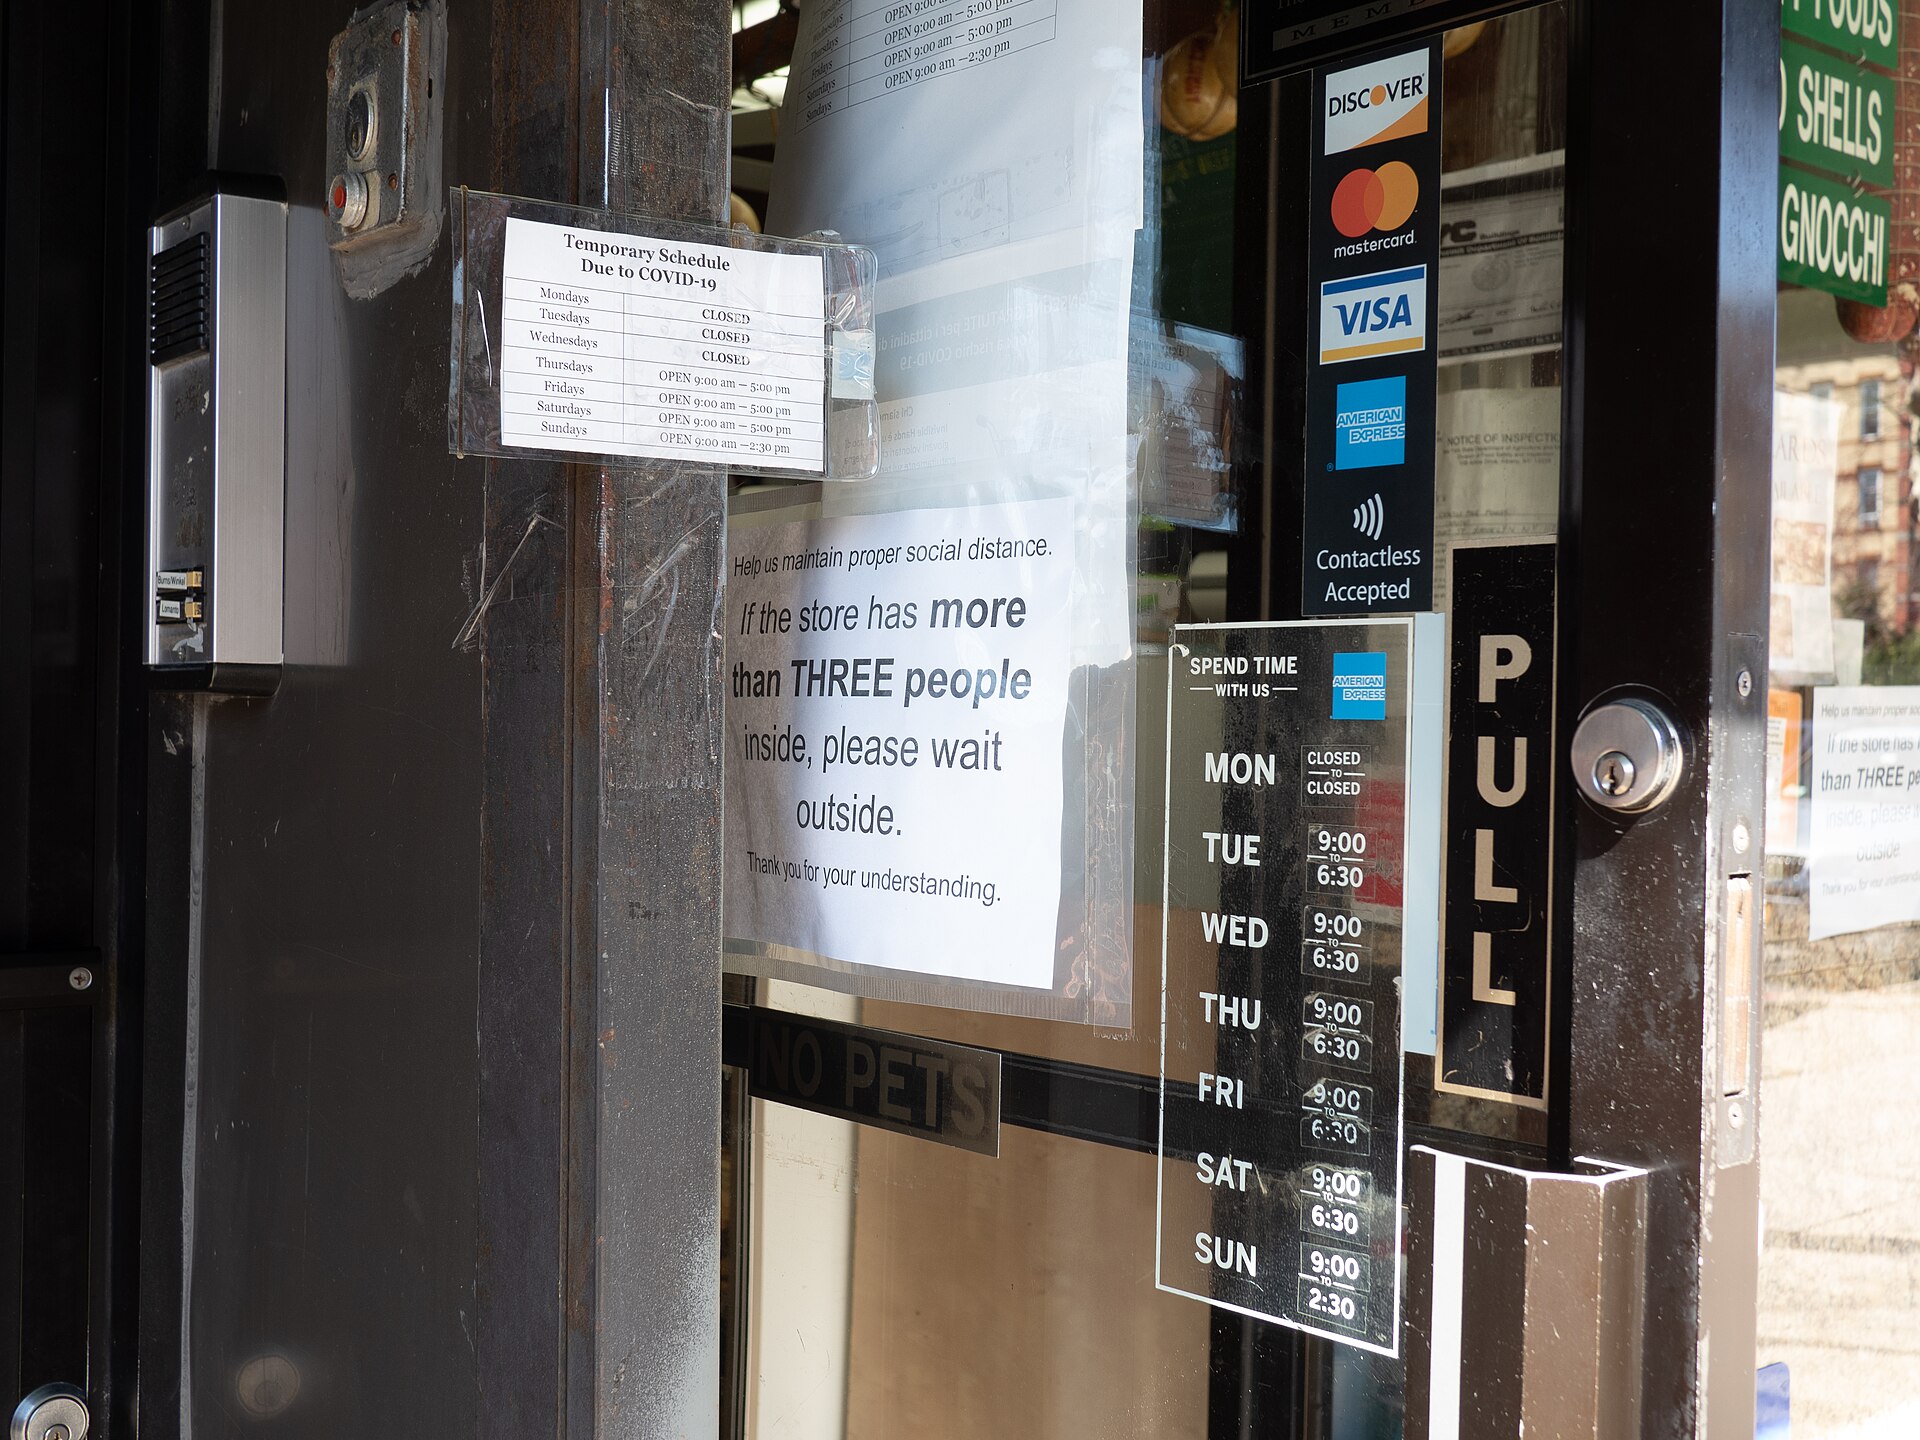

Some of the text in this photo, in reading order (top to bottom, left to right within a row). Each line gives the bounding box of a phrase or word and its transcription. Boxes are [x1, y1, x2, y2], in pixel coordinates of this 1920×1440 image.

[884, 3, 912, 24] OPEN
[884, 0, 992, 46] OPEN 9:00 am 5:00
[884, 16, 1012, 68] OPEN 9:00 am 5:00 pm
[885, 69, 912, 89] OPEN
[915, 63, 936, 81] 9:00
[939, 58, 955, 71] am
[994, 40, 1010, 57] pm
[1328, 74, 1424, 118] DISCOVER
[1798, 64, 1882, 166] SHELLS
[1334, 230, 1415, 258] mastercard
[1781, 183, 1885, 288] GNOCCHI
[564, 233, 730, 272] Temporary Schedule
[580, 258, 717, 292] Due to COVID-19
[540, 288, 590, 304] Mondays
[540, 308, 590, 325] Tuesdays
[702, 309, 750, 325] CLOSED
[1332, 294, 1412, 336] VISA
[530, 330, 598, 350] Wednesdays
[702, 328, 750, 344] CLOSED
[536, 356, 593, 374] Thursdays
[702, 350, 750, 366] CLOSED
[544, 380, 585, 396] Fridays
[659, 370, 790, 396] OPEN 9:00 am 5:00 pm
[537, 400, 592, 417] Saturdays
[659, 392, 791, 418] OPEN 9:00 am 5:00 pm
[1336, 406, 1402, 428] AMERICAN
[540, 421, 587, 436] Sundays
[658, 412, 792, 438] OPEN 9:00 am 5:00 pm
[1350, 424, 1406, 444] EXPRESS
[660, 432, 692, 445] OPEN
[694, 436, 718, 449] 9:00
[721, 439, 737, 450] am
[774, 444, 790, 455] pm
[734, 535, 1053, 579] Help us maintain proper social distance.
[1316, 545, 1421, 570] Contactless
[1324, 578, 1410, 606] Accepted
[740, 595, 1027, 636] If the store has more
[1190, 656, 1298, 676] SPEND TIME
[732, 657, 1032, 710] than THREE people
[1215, 683, 1270, 698] WITH US
[1332, 676, 1383, 687] AMERICAN
[1344, 689, 1386, 700] EXPRESS
[744, 724, 1002, 774] inside, please wait
[1307, 750, 1361, 766] CLOSED
[1204, 752, 1276, 786] MON
[1331, 768, 1342, 778] TO
[1821, 769, 1852, 792] than
[1856, 766, 1904, 790] THREE
[1307, 782, 1361, 796] CLOSED
[796, 793, 902, 836] outside.
[1472, 634, 1532, 1006] PULL
[1202, 832, 1261, 867] TUE
[1318, 830, 1366, 854] 9:00
[1330, 854, 1341, 863] TO
[746, 850, 1002, 907] Thank you for your understanding.
[1317, 866, 1364, 888] 6:30
[1201, 912, 1269, 949] WED
[1314, 913, 1362, 938] 9:00
[1328, 938, 1339, 948] TO
[1312, 948, 1360, 974] 6:30
[1200, 992, 1262, 1030] THU
[1314, 998, 1362, 1026] 9:00
[1326, 1022, 1338, 1032] TO
[1313, 1034, 1360, 1061] 6:30
[759, 1020, 986, 1137] NO PETS
[1198, 1072, 1244, 1110] FRI
[1313, 1083, 1361, 1112] 9:00
[1324, 1107, 1336, 1117] TO
[1196, 1152, 1252, 1192] SAT
[1312, 1170, 1361, 1197] 9:00
[1322, 1191, 1334, 1201] TO
[1311, 1205, 1359, 1235] 6:30
[1194, 1232, 1258, 1278] SUN
[1310, 1250, 1360, 1280] 9:00
[1320, 1276, 1332, 1286] TO
[1308, 1288, 1355, 1320] 2:30
